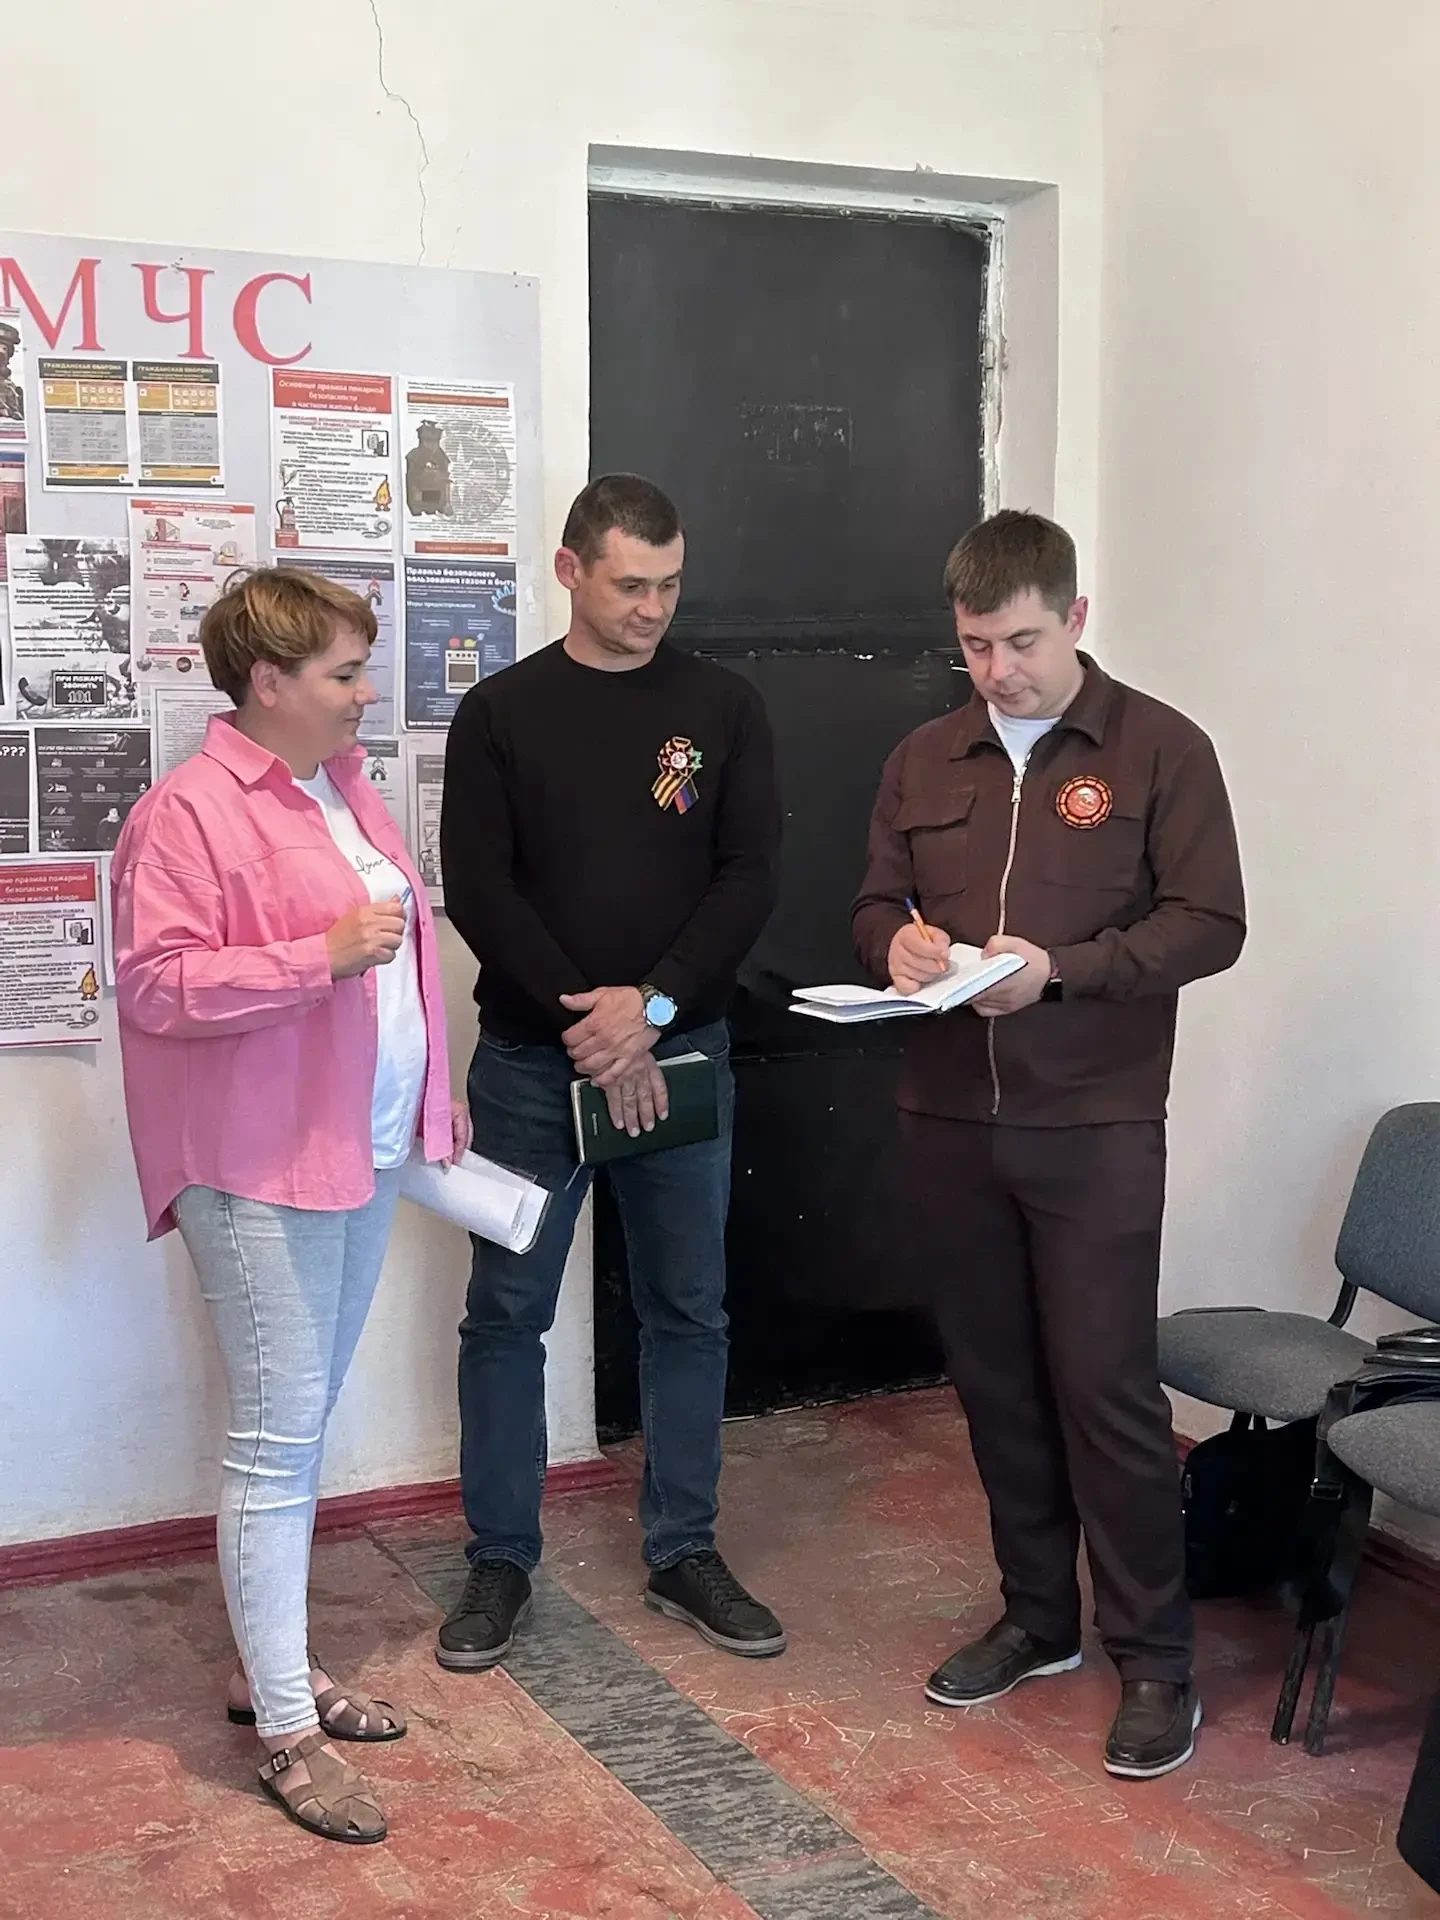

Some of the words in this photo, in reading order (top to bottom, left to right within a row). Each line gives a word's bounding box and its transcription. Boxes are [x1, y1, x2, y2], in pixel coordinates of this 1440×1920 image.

[0, 257, 312, 365] МЧС
[406, 567, 442, 576] Правила
[443, 567, 496, 578] безопасного
[68, 690, 92, 703] 101
